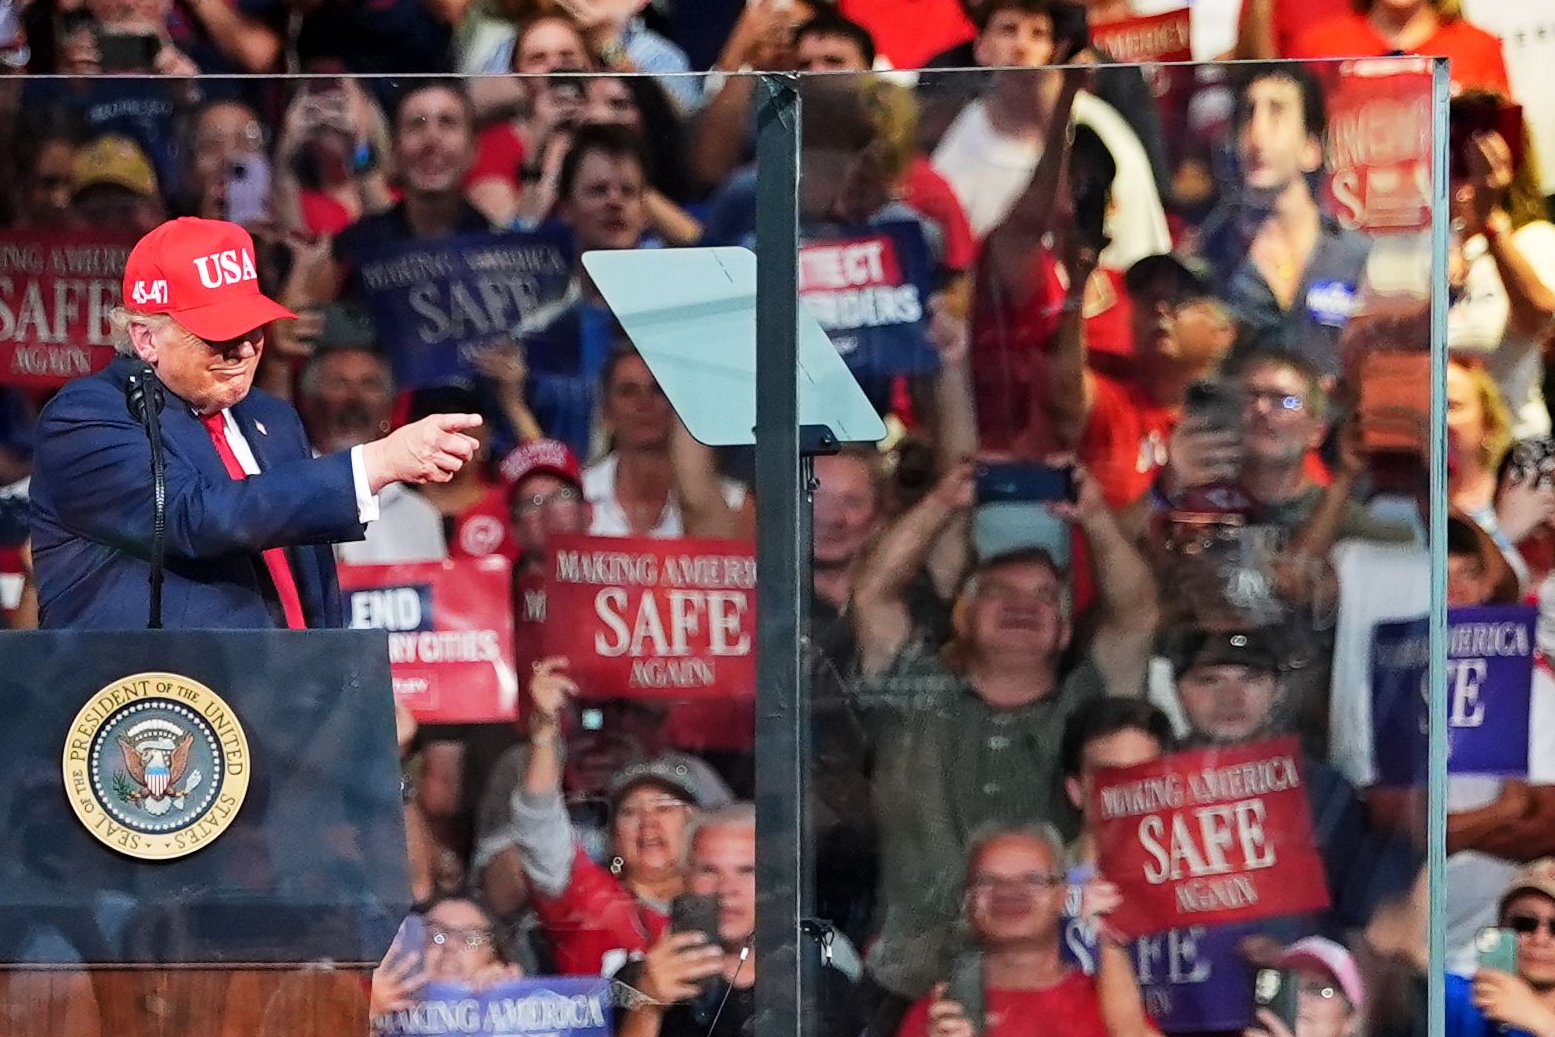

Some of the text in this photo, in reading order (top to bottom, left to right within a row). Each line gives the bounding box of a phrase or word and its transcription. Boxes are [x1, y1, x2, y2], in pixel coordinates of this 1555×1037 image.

[193, 247, 257, 289] USA
[131, 278, 169, 305] 45-47
[556, 547, 757, 589] MAKING AMERI
[347, 587, 422, 631] END
[593, 585, 751, 657] SAFE
[628, 656, 717, 689] AGAIN
[70, 679, 244, 850] SEAL OF THE PRESIDENT OF THE UNITED STATES
[1187, 754, 1300, 806] AMERICA
[1138, 798, 1277, 884] SAFE
[484, 993, 606, 1033] AMERICA
